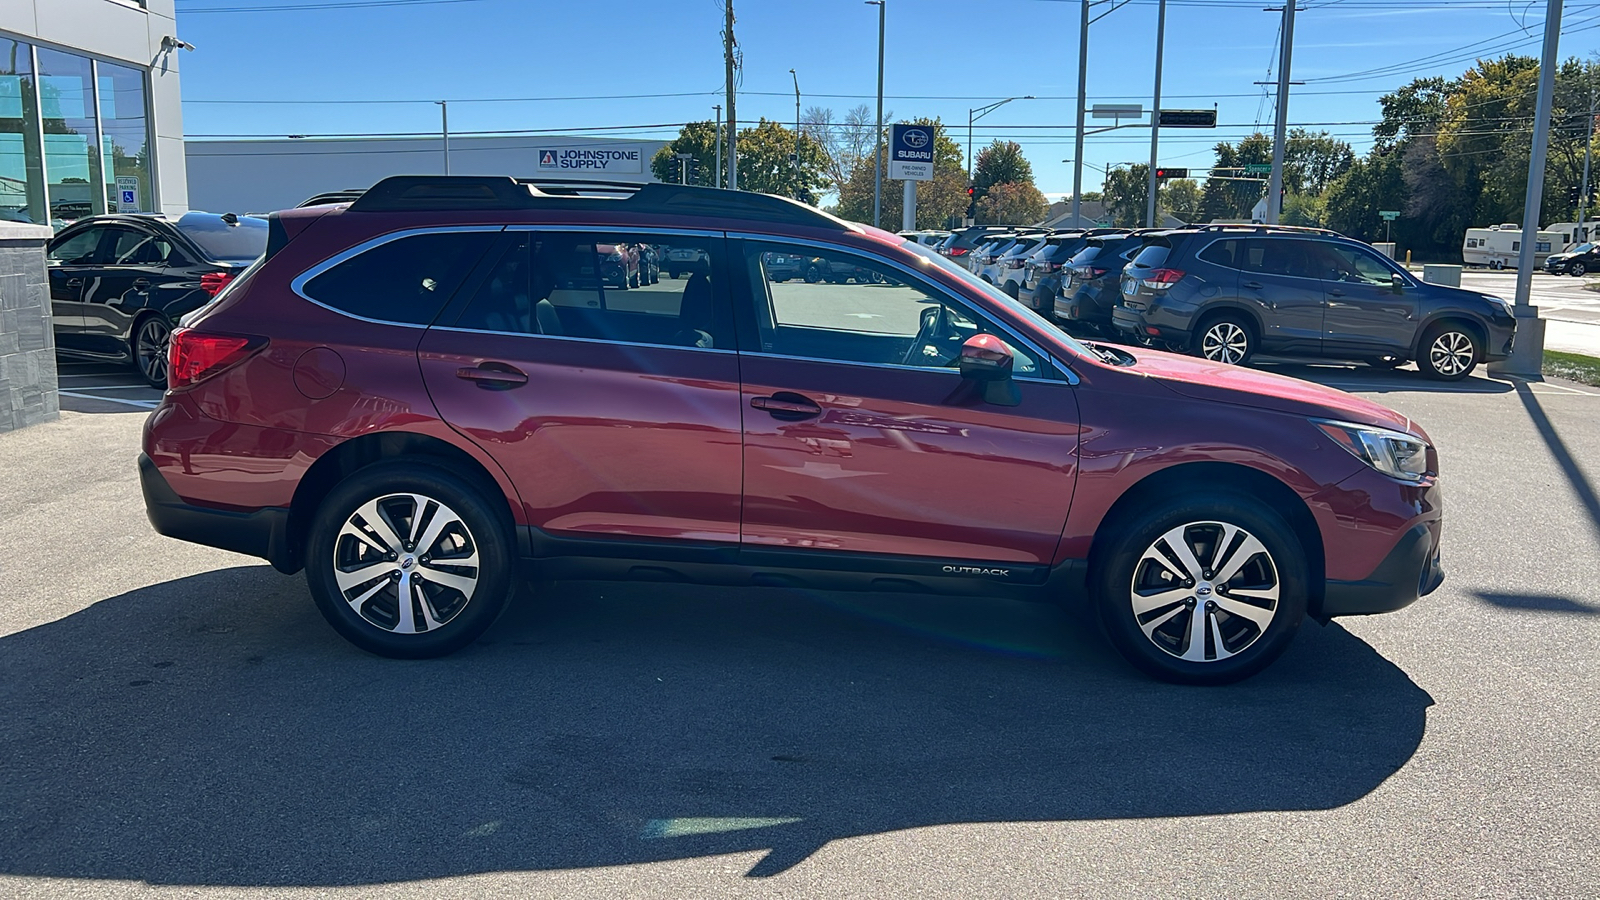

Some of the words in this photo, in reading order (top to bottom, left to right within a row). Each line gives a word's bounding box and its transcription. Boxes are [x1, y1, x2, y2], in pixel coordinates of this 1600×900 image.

[560, 150, 638, 160] JOHNSTONE
[898, 150, 931, 159] SUBARU
[560, 159, 609, 169] SUPPLY
[942, 565, 1009, 577] OUTBACK
